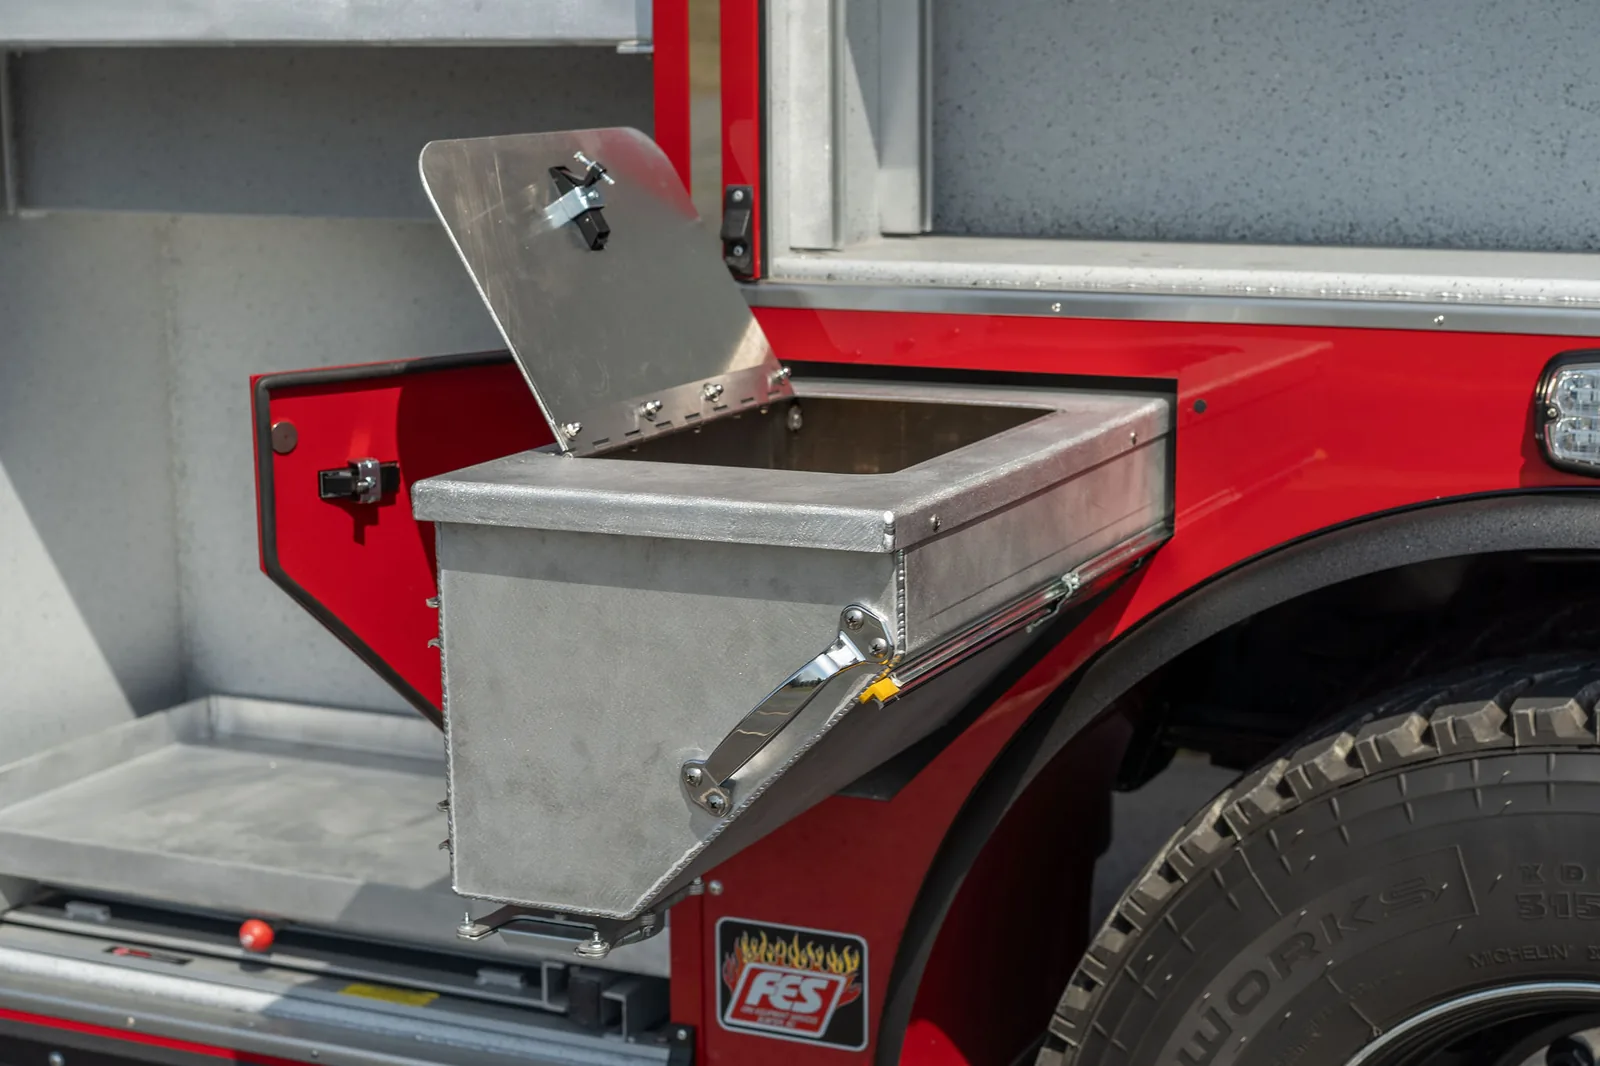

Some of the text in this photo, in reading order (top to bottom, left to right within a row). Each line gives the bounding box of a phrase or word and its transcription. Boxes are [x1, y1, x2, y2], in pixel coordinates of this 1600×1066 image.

[1176, 875, 1438, 1066] WORKS
[1467, 943, 1569, 969] MICHELIN
[744, 971, 829, 1013] FES
